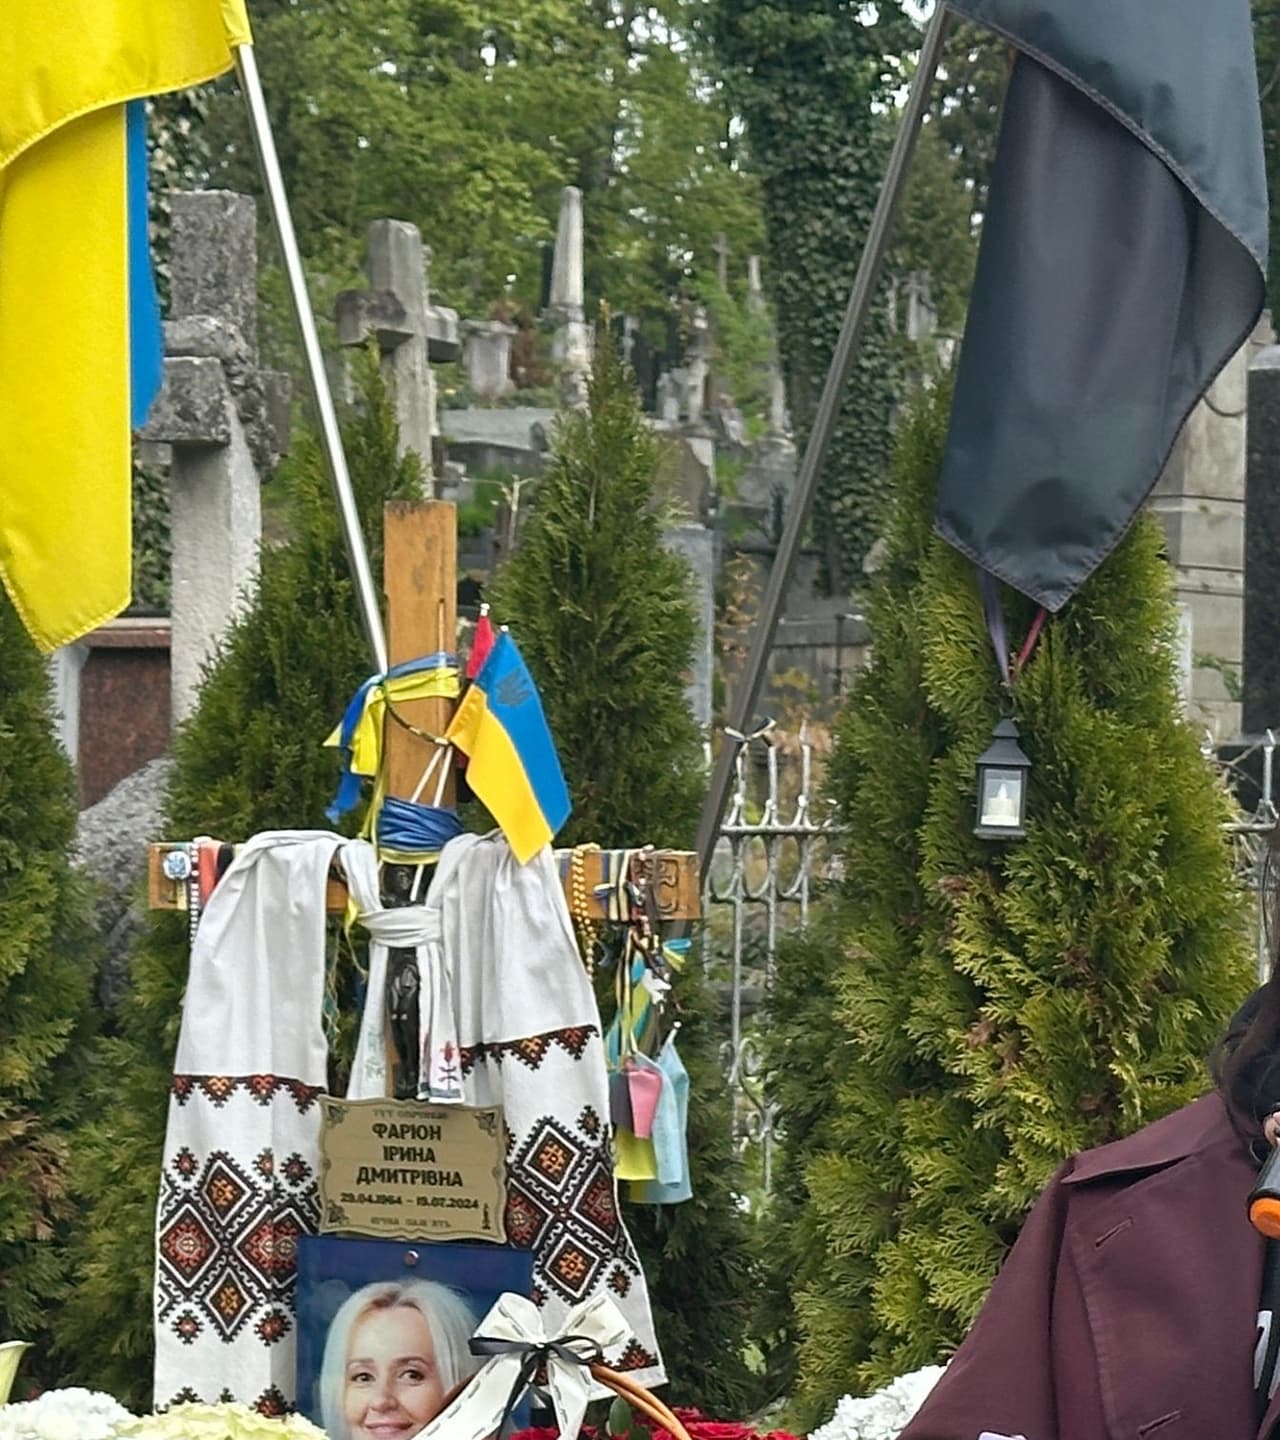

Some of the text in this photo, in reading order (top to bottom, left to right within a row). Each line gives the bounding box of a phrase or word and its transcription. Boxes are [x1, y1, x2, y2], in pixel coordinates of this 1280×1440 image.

[372, 1122, 442, 1141] ФАРІОН
[383, 1145, 436, 1162] ІРИНА
[356, 1166, 463, 1187] ДМИТРІВНА
